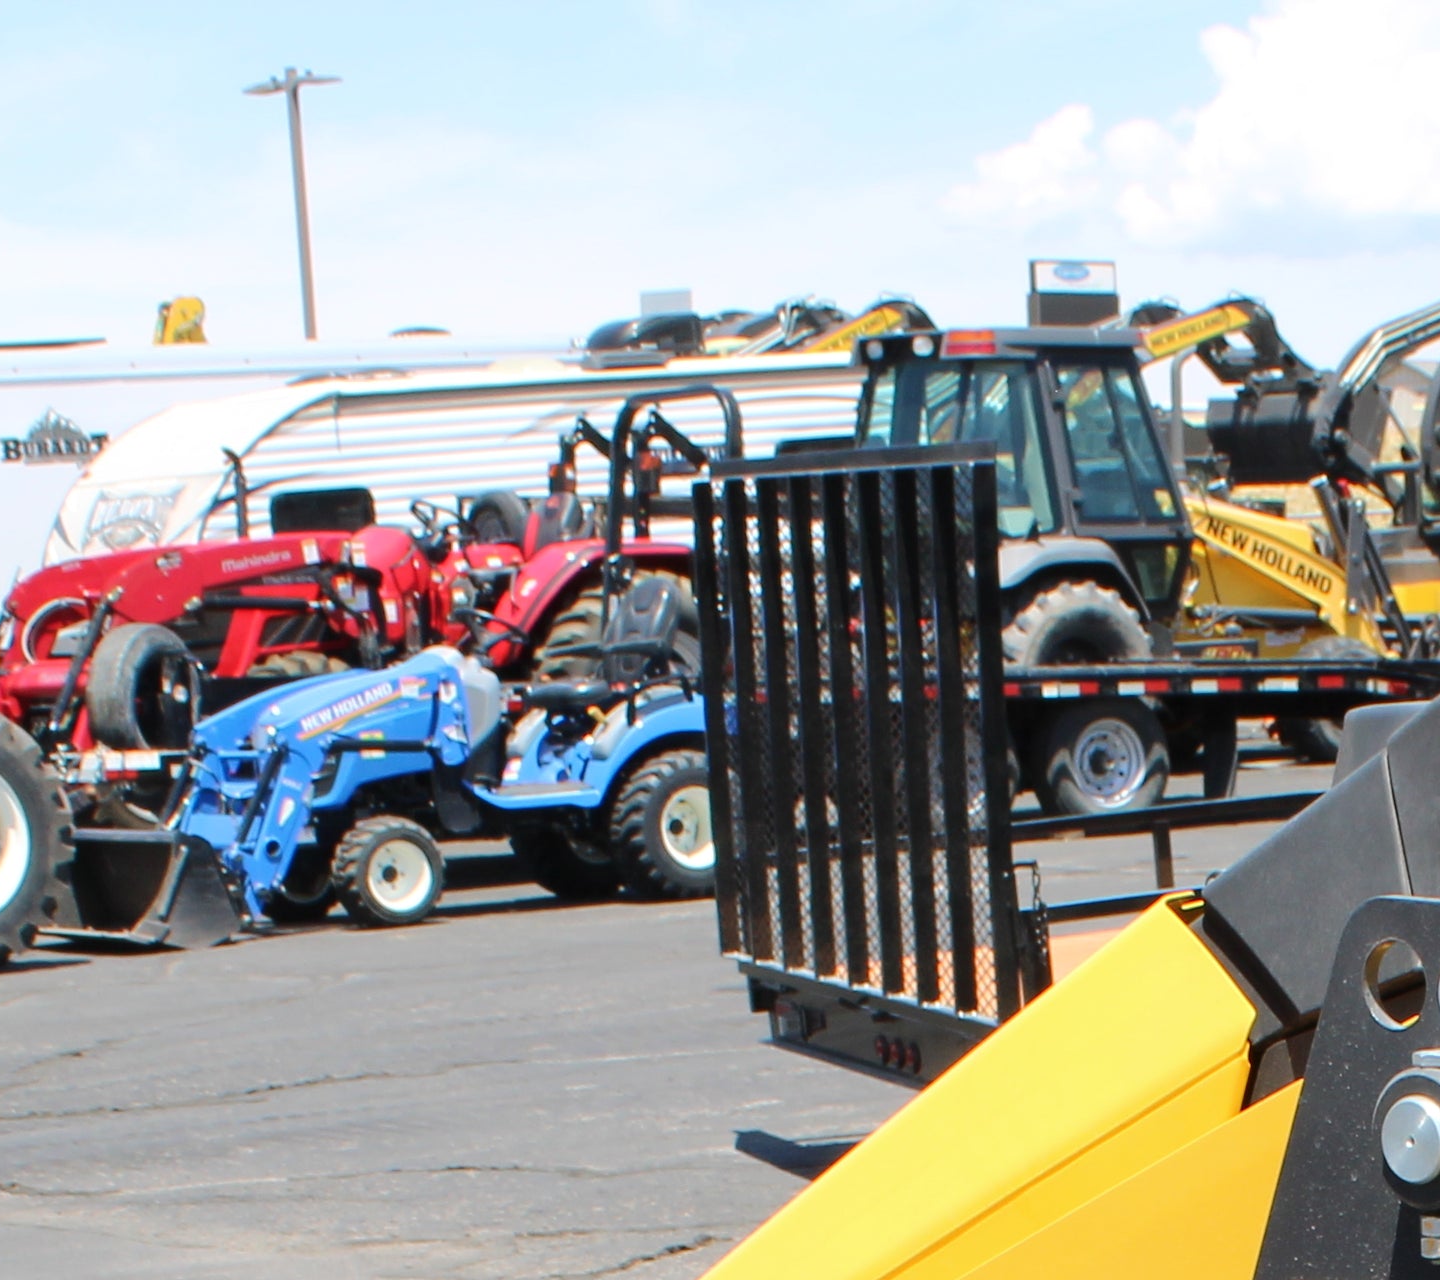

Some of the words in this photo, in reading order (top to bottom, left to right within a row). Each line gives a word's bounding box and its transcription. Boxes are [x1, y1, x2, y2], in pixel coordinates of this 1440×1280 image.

[221, 550, 292, 574] Mahindra
[1206, 517, 1249, 550] NEW
[1251, 541, 1333, 595] HOLLAND
[300, 708, 334, 732] NEW
[333, 682, 394, 718] HOLLAND
